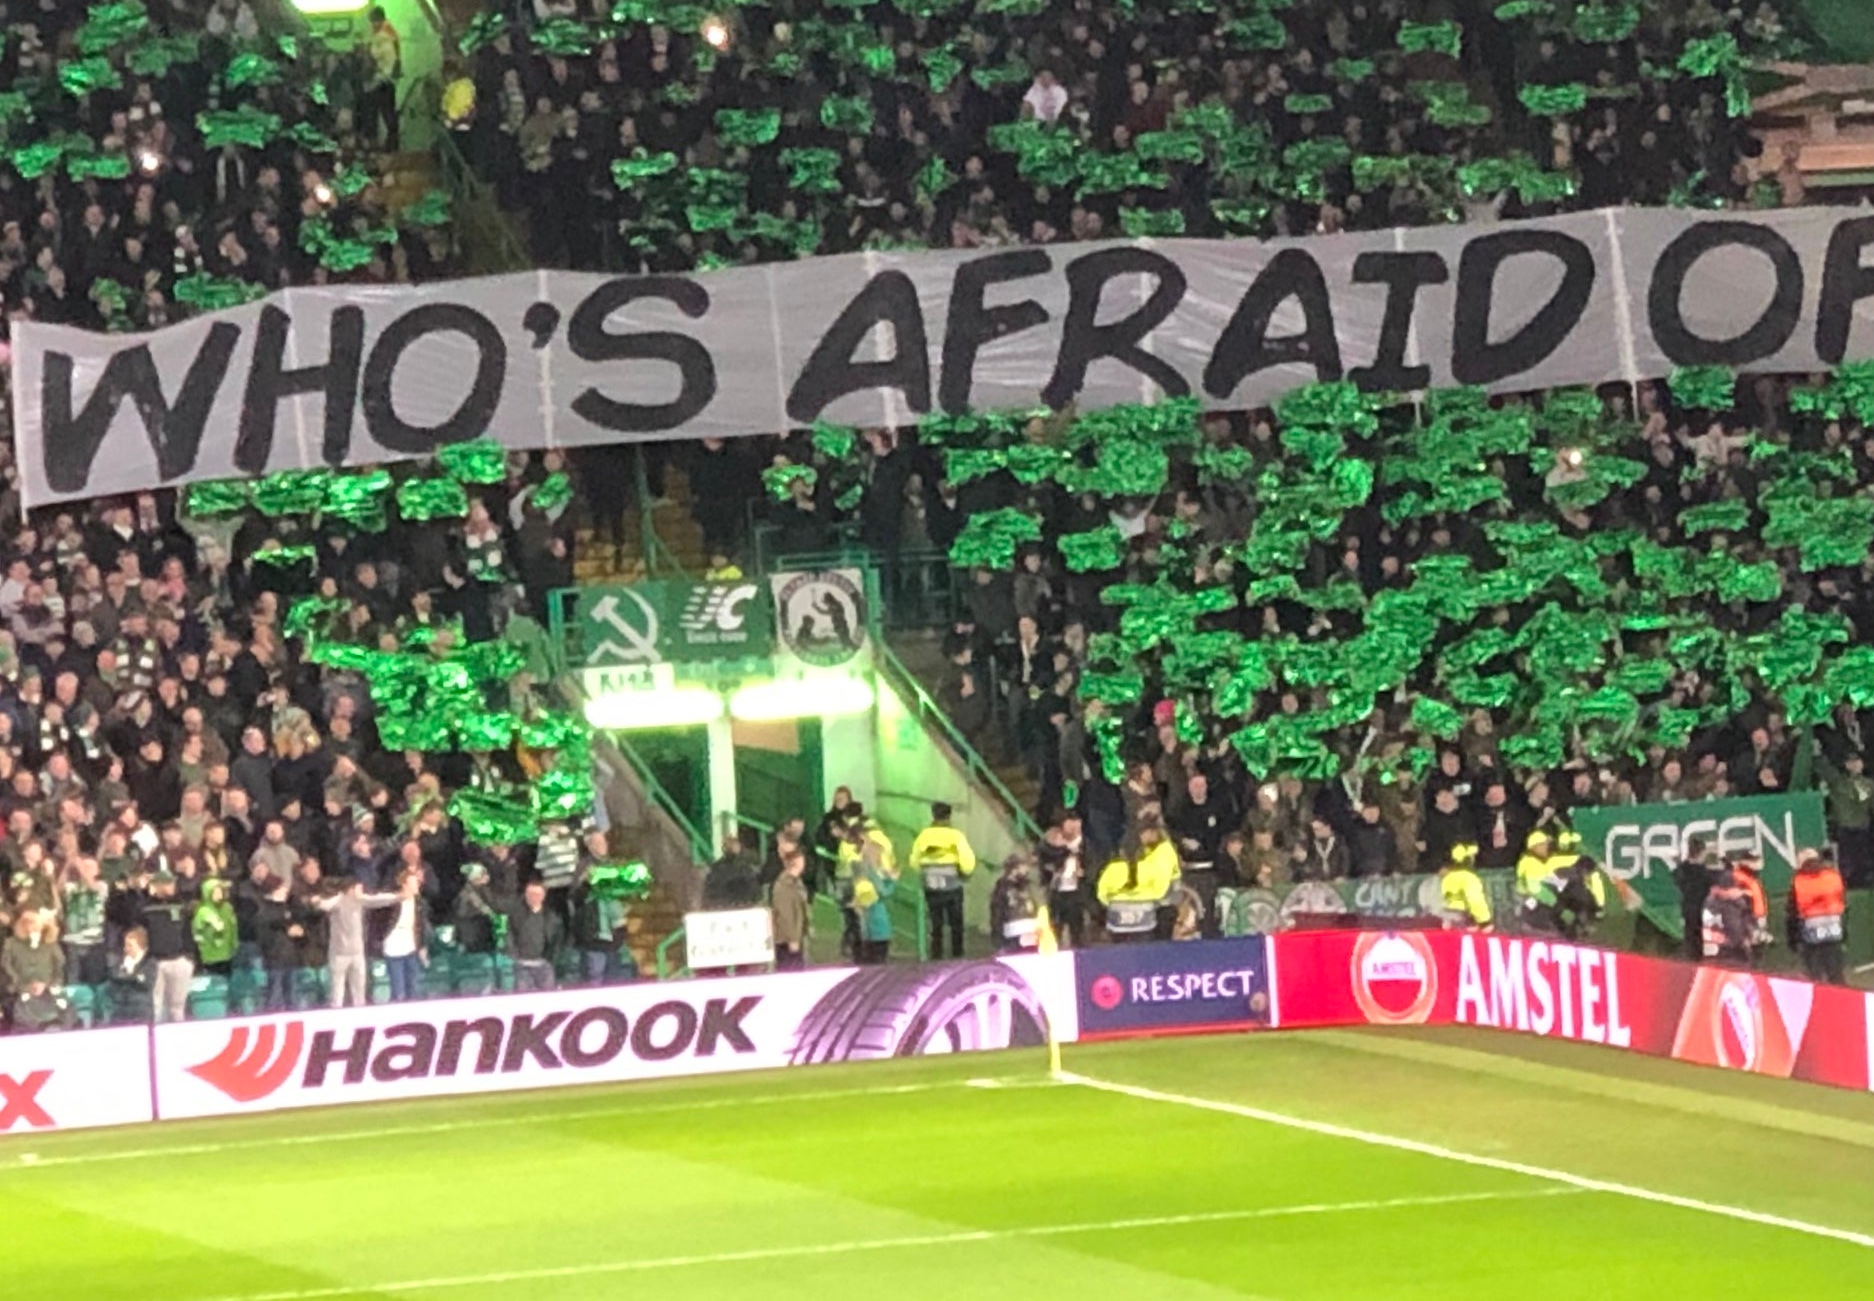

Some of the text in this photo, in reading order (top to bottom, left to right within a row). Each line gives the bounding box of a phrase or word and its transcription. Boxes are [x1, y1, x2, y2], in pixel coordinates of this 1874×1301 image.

[43, 275, 717, 493] WHO'S
[786, 230, 1596, 422] AFRAID
[1131, 969, 1255, 1003] RESPECT
[1456, 935, 1632, 1047] AMSTEL
